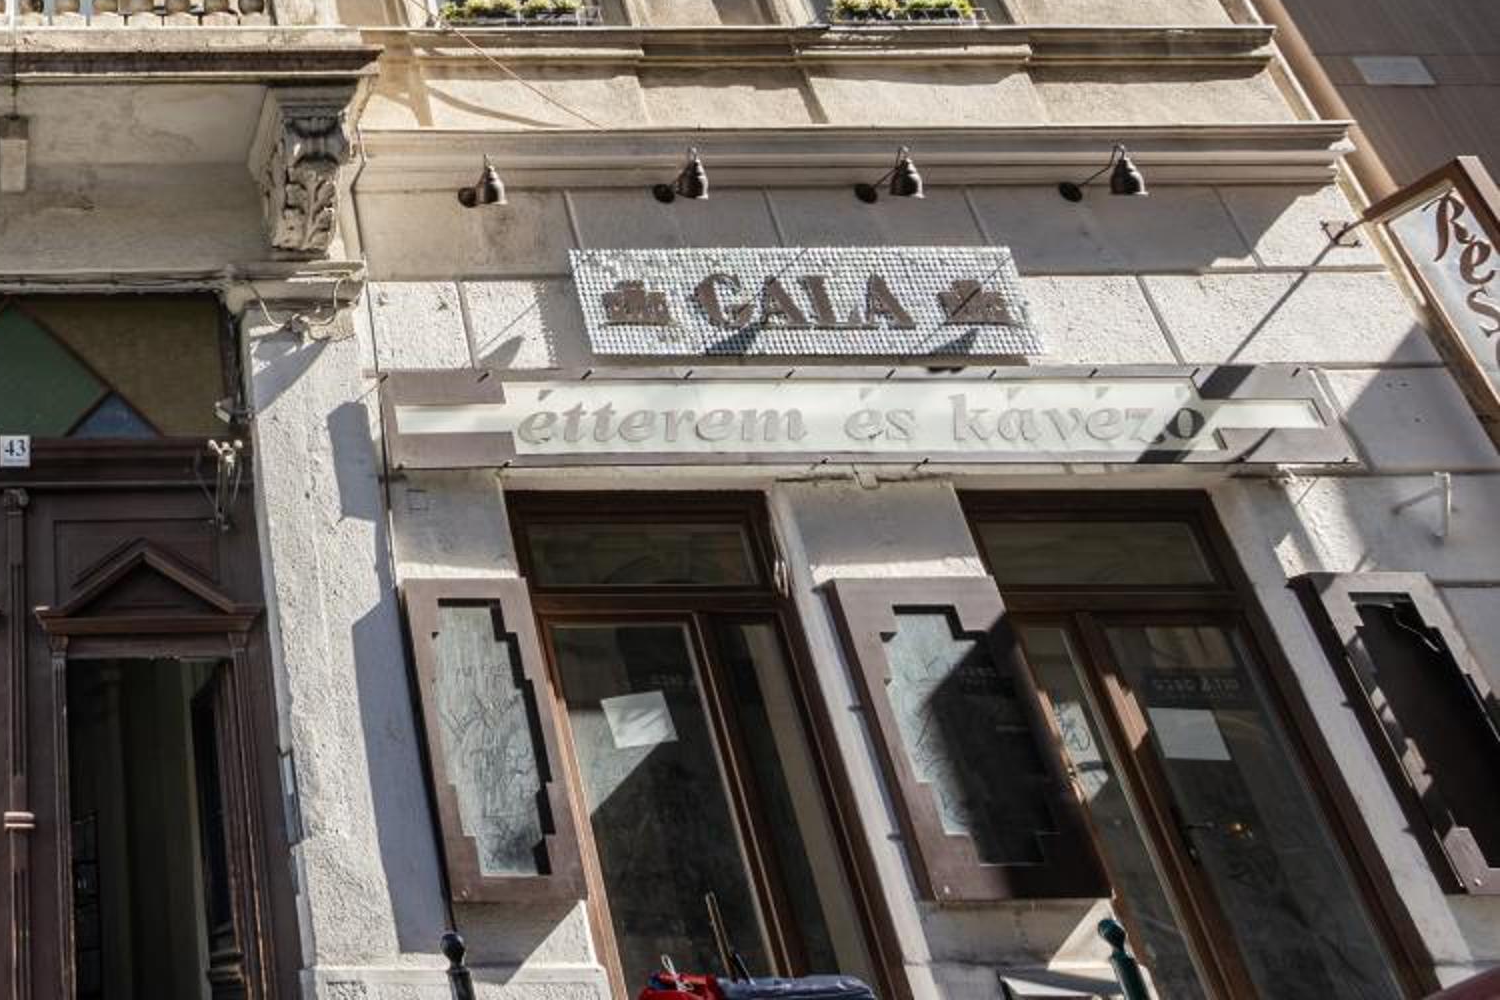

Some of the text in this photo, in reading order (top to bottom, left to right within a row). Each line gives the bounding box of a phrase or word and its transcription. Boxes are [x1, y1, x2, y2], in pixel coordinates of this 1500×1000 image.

[688, 272, 918, 330] GALA
[1422, 186, 1500, 372] Res
[516, 386, 1206, 444] étterem és kávézó
[3, 438, 27, 457] 43
